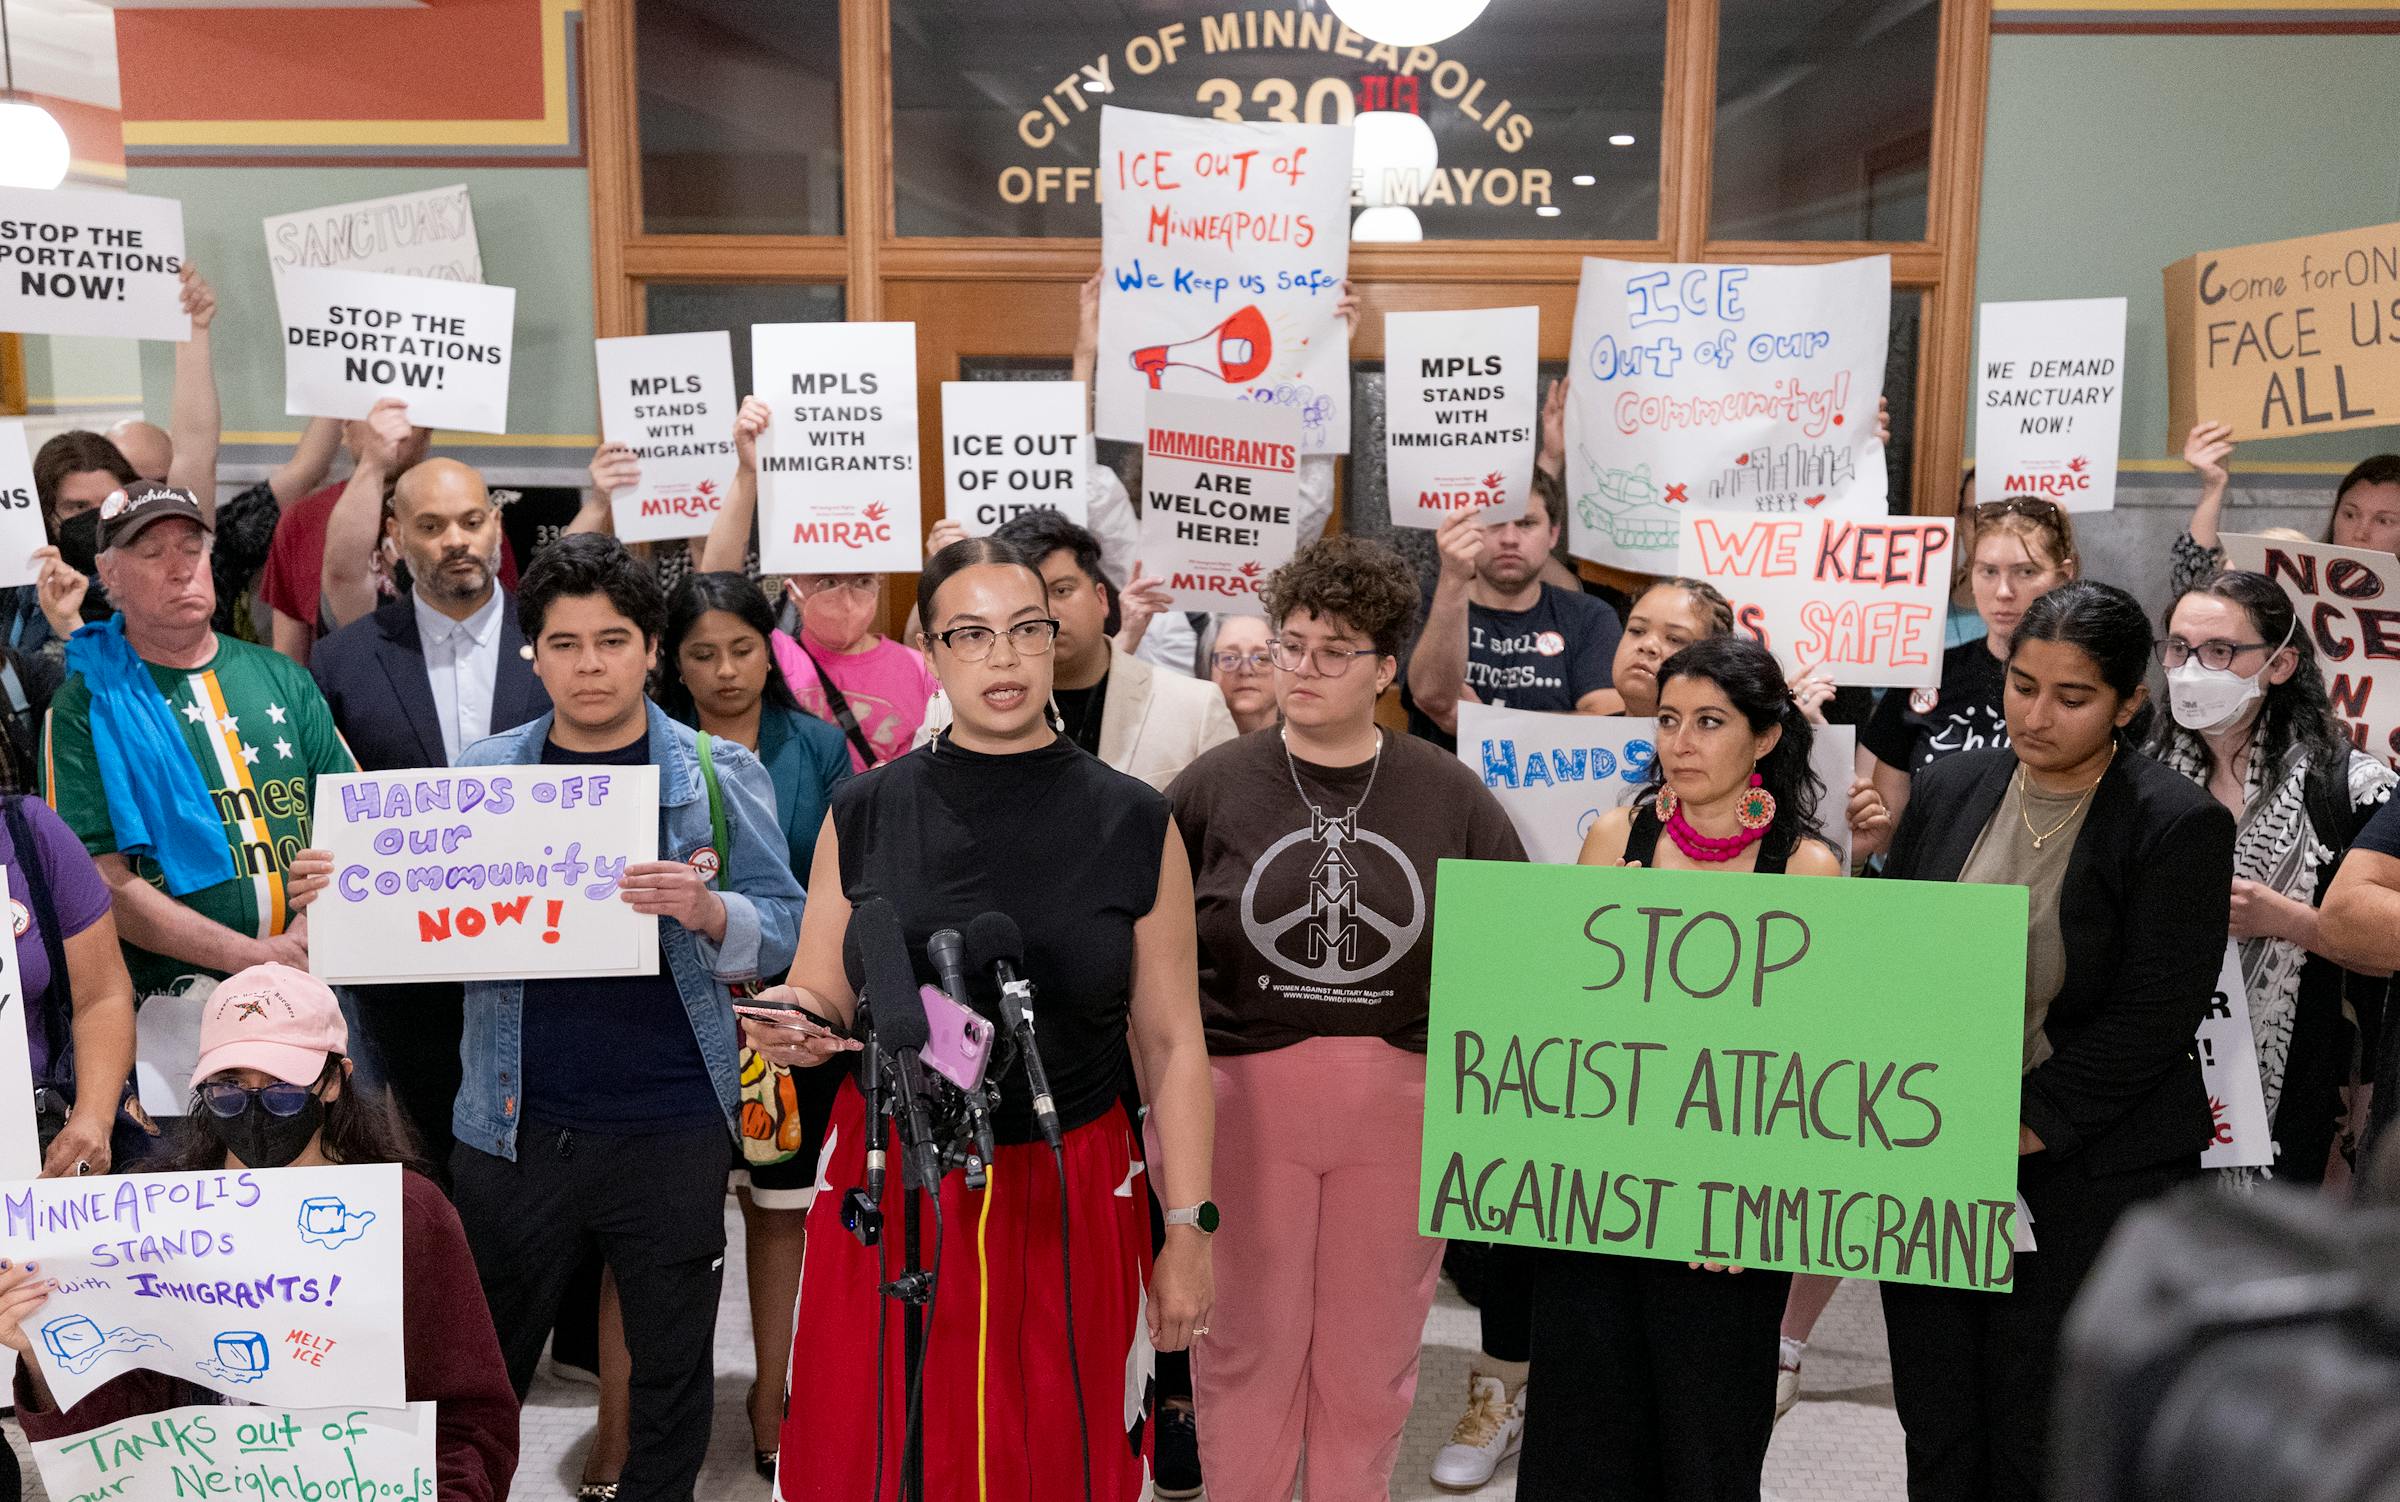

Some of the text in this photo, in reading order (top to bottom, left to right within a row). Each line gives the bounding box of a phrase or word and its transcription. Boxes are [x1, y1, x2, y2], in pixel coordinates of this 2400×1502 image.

[1018, 54, 1115, 149] CITY
[1125, 22, 1187, 76] OF
[1201, 9, 1534, 153] MINNEAPOLIS
[1196, 78, 1355, 125] 330
[1119, 150, 1180, 190] ICE
[1272, 147, 1307, 186] of
[999, 166, 1104, 203] OFFI
[1383, 167, 1552, 206] MAYOR
[0, 220, 143, 248] STOP THE
[275, 191, 468, 268] SANCTUARY
[21, 272, 125, 300] NOW!
[1115, 260, 1163, 291] We
[1173, 267, 1229, 303] Keep
[1239, 274, 1265, 294] us
[2200, 260, 2287, 305] Come
[2301, 255, 2342, 291] for
[1626, 268, 1749, 329] ICE
[329, 306, 466, 336] STOP THE
[288, 327, 502, 364] DEPORTATIONS
[2208, 307, 2321, 368] FACE
[1420, 354, 1502, 379] MPLS
[1590, 334, 1682, 381] Out
[1694, 329, 1736, 369] of
[1986, 358, 2115, 379] WE DEMAND
[345, 357, 445, 389] NOW!
[630, 375, 702, 396] MPLS
[792, 373, 878, 394] MPLS
[1422, 386, 1505, 402] STANDS
[1615, 369, 1851, 438] Community!
[1986, 386, 2115, 408] SANCTUARY
[2261, 365, 2375, 429] ALL
[634, 402, 708, 418] STANDS
[794, 407, 882, 422] STANDS
[1435, 408, 1487, 425] WITH
[2020, 415, 2074, 435] NOW!
[647, 424, 694, 438] WITH
[808, 431, 865, 446] WITH
[953, 435, 1077, 456] ICE OUT
[1391, 428, 1530, 447] IMMIGRANTS!
[609, 441, 735, 458] MIGRANTS!
[1148, 428, 1296, 469] IMMIGRANTS
[762, 456, 912, 472] IMMIGRANTS!
[958, 469, 1073, 490] OF OUR
[1194, 472, 1252, 496] ARE
[2004, 474, 2091, 496] MIRAC
[641, 496, 721, 517] MIRAC
[977, 503, 1056, 524] CIT
[1149, 490, 1291, 524] WELCOME
[1418, 490, 1506, 510] MIRAC
[793, 522, 891, 548] MIRAC
[1176, 521, 1259, 546] HERE!
[1694, 518, 1951, 589] WE KEEP
[1170, 573, 1264, 596] MIRAC
[2265, 548, 2385, 600] NO
[1471, 627, 1485, 648] I
[1729, 600, 1932, 667] S SAFE
[2312, 601, 2400, 661] CE
[1481, 739, 1656, 789] HANDS
[208, 777, 308, 824] mes
[340, 775, 513, 822] HANDS
[339, 841, 626, 902] Community
[417, 895, 563, 944] NOW!
[1581, 903, 1810, 1007] STOP
[1272, 984, 1300, 992] WOMEN
[1300, 985, 1332, 994] AGAINST
[1332, 988, 1364, 997] MILITARY
[1453, 1030, 1942, 1151] RACIST ATTACKS
[1430, 1151, 2016, 1288] AGAINST IMMIGRANTS
[56, 1272, 342, 1308] with IMMIGRANTS!
[286, 1329, 337, 1351] MELT
[292, 1347, 325, 1368] ICE
[60, 1411, 368, 1474] TANKS out of
[170, 1446, 433, 1502] Neighborhoods
